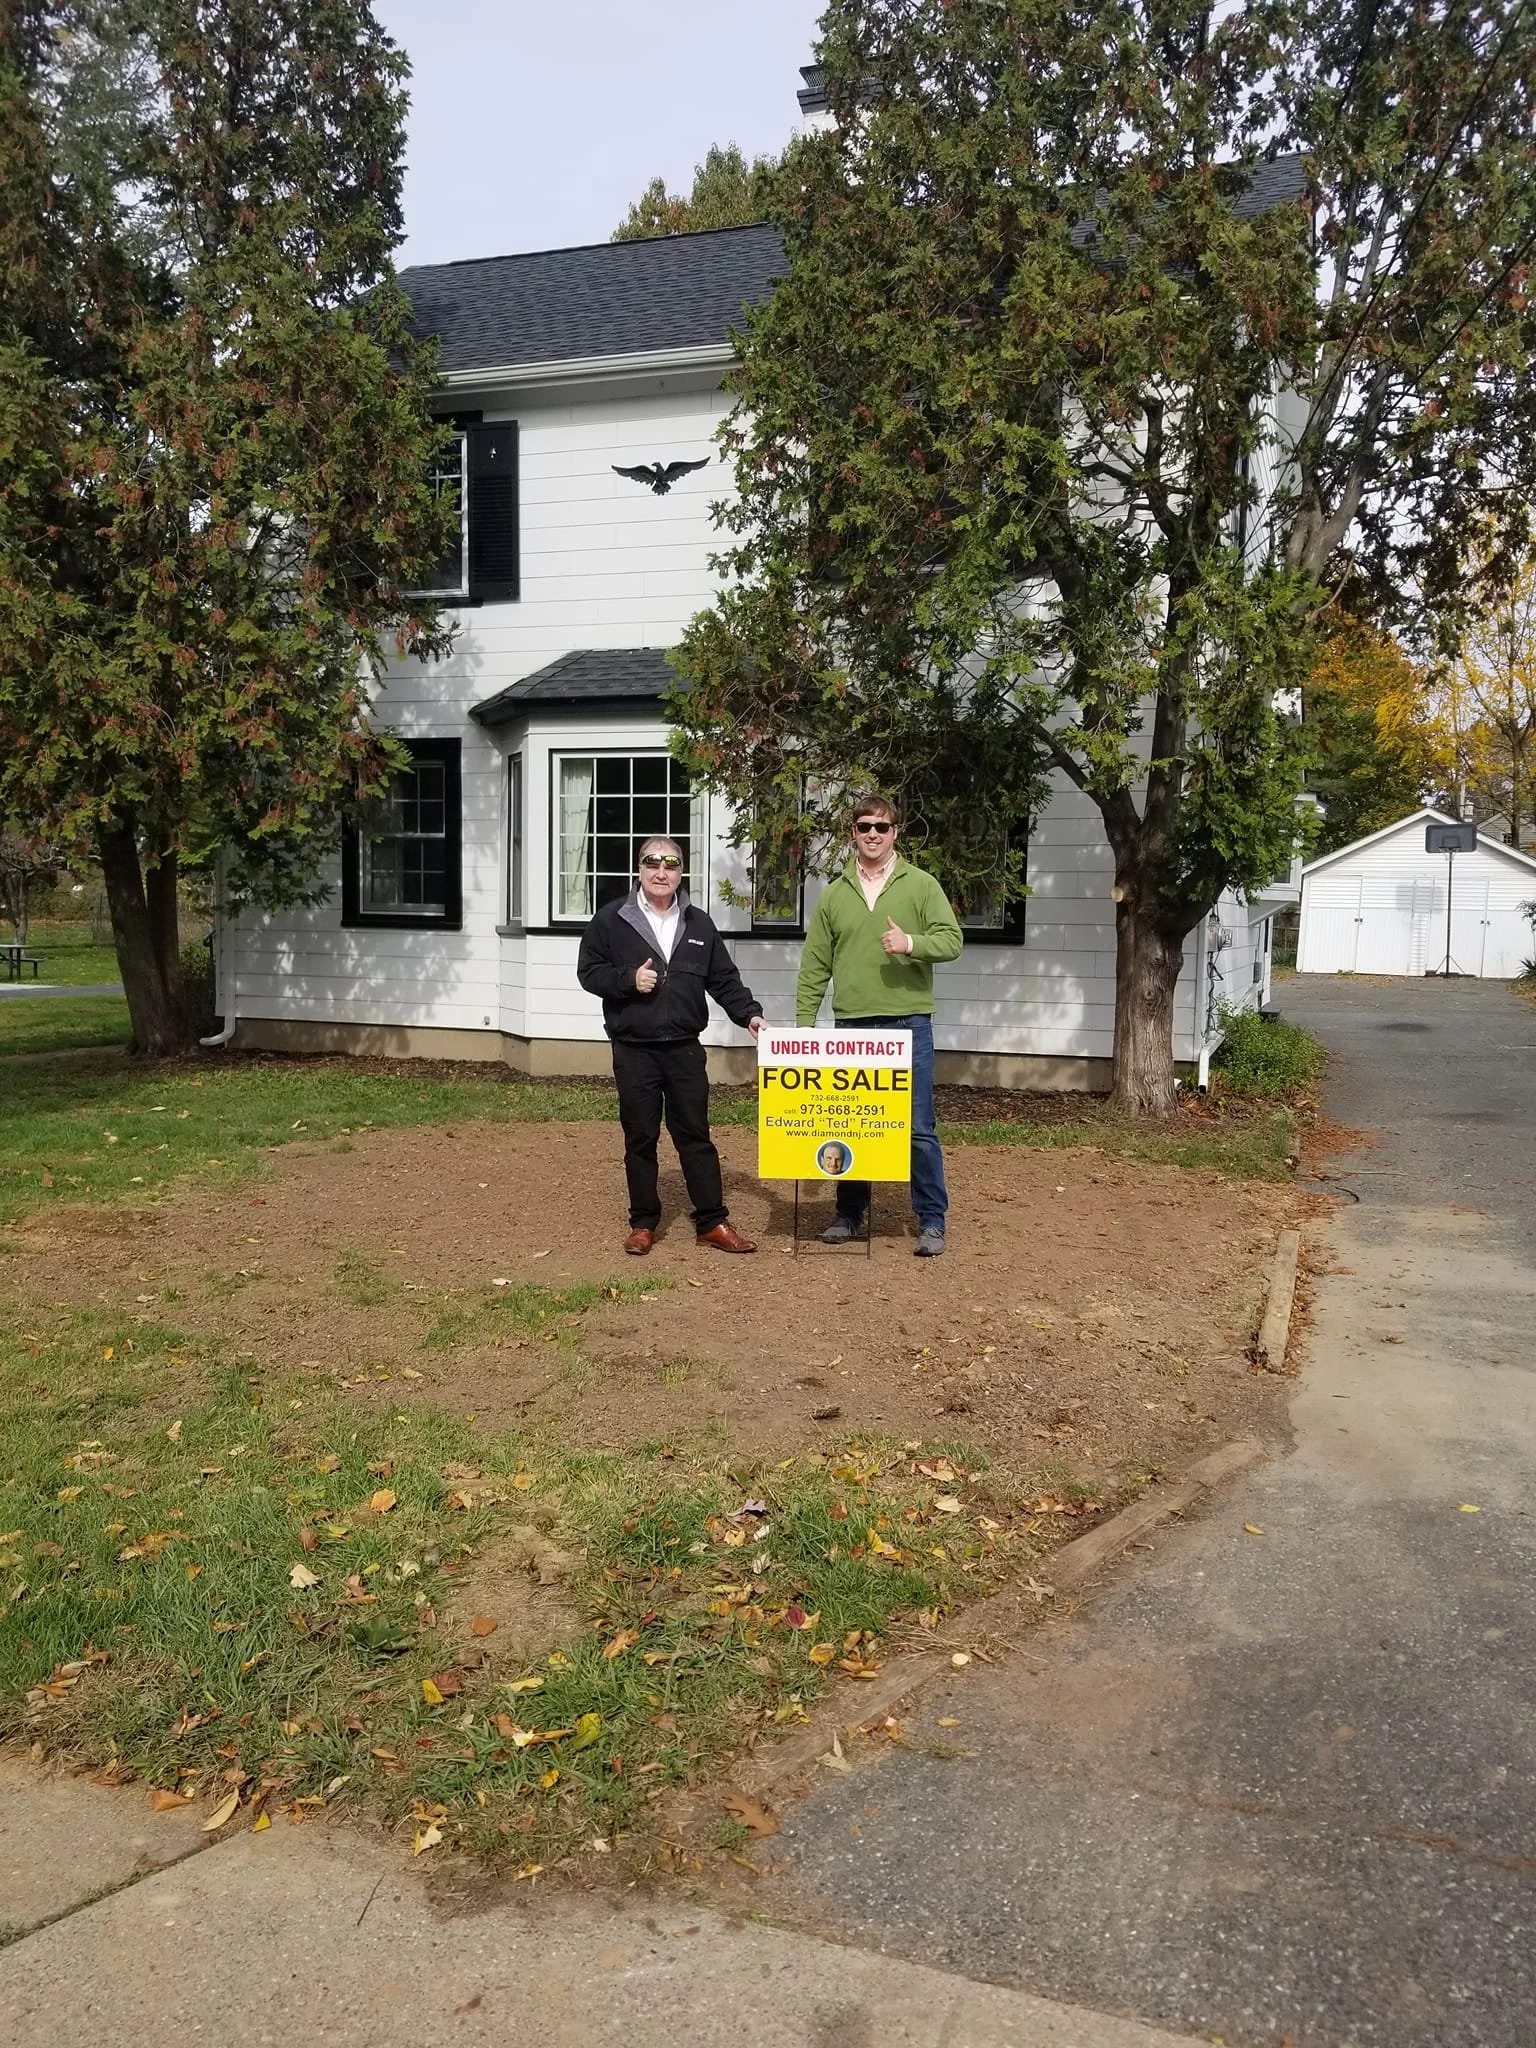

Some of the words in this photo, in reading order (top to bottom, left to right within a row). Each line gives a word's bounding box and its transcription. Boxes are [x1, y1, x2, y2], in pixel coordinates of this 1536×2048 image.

[771, 1041, 820, 1055] UNDER
[826, 1041, 905, 1056] CONTRACT
[763, 1068, 823, 1090] FOR
[832, 1069, 909, 1091] SALE
[800, 1104, 885, 1116] 973-668-2591
[765, 1117, 815, 1128] Edward
[860, 1118, 905, 1129] France
[785, 1129, 885, 1140] www.diamondnj.com
